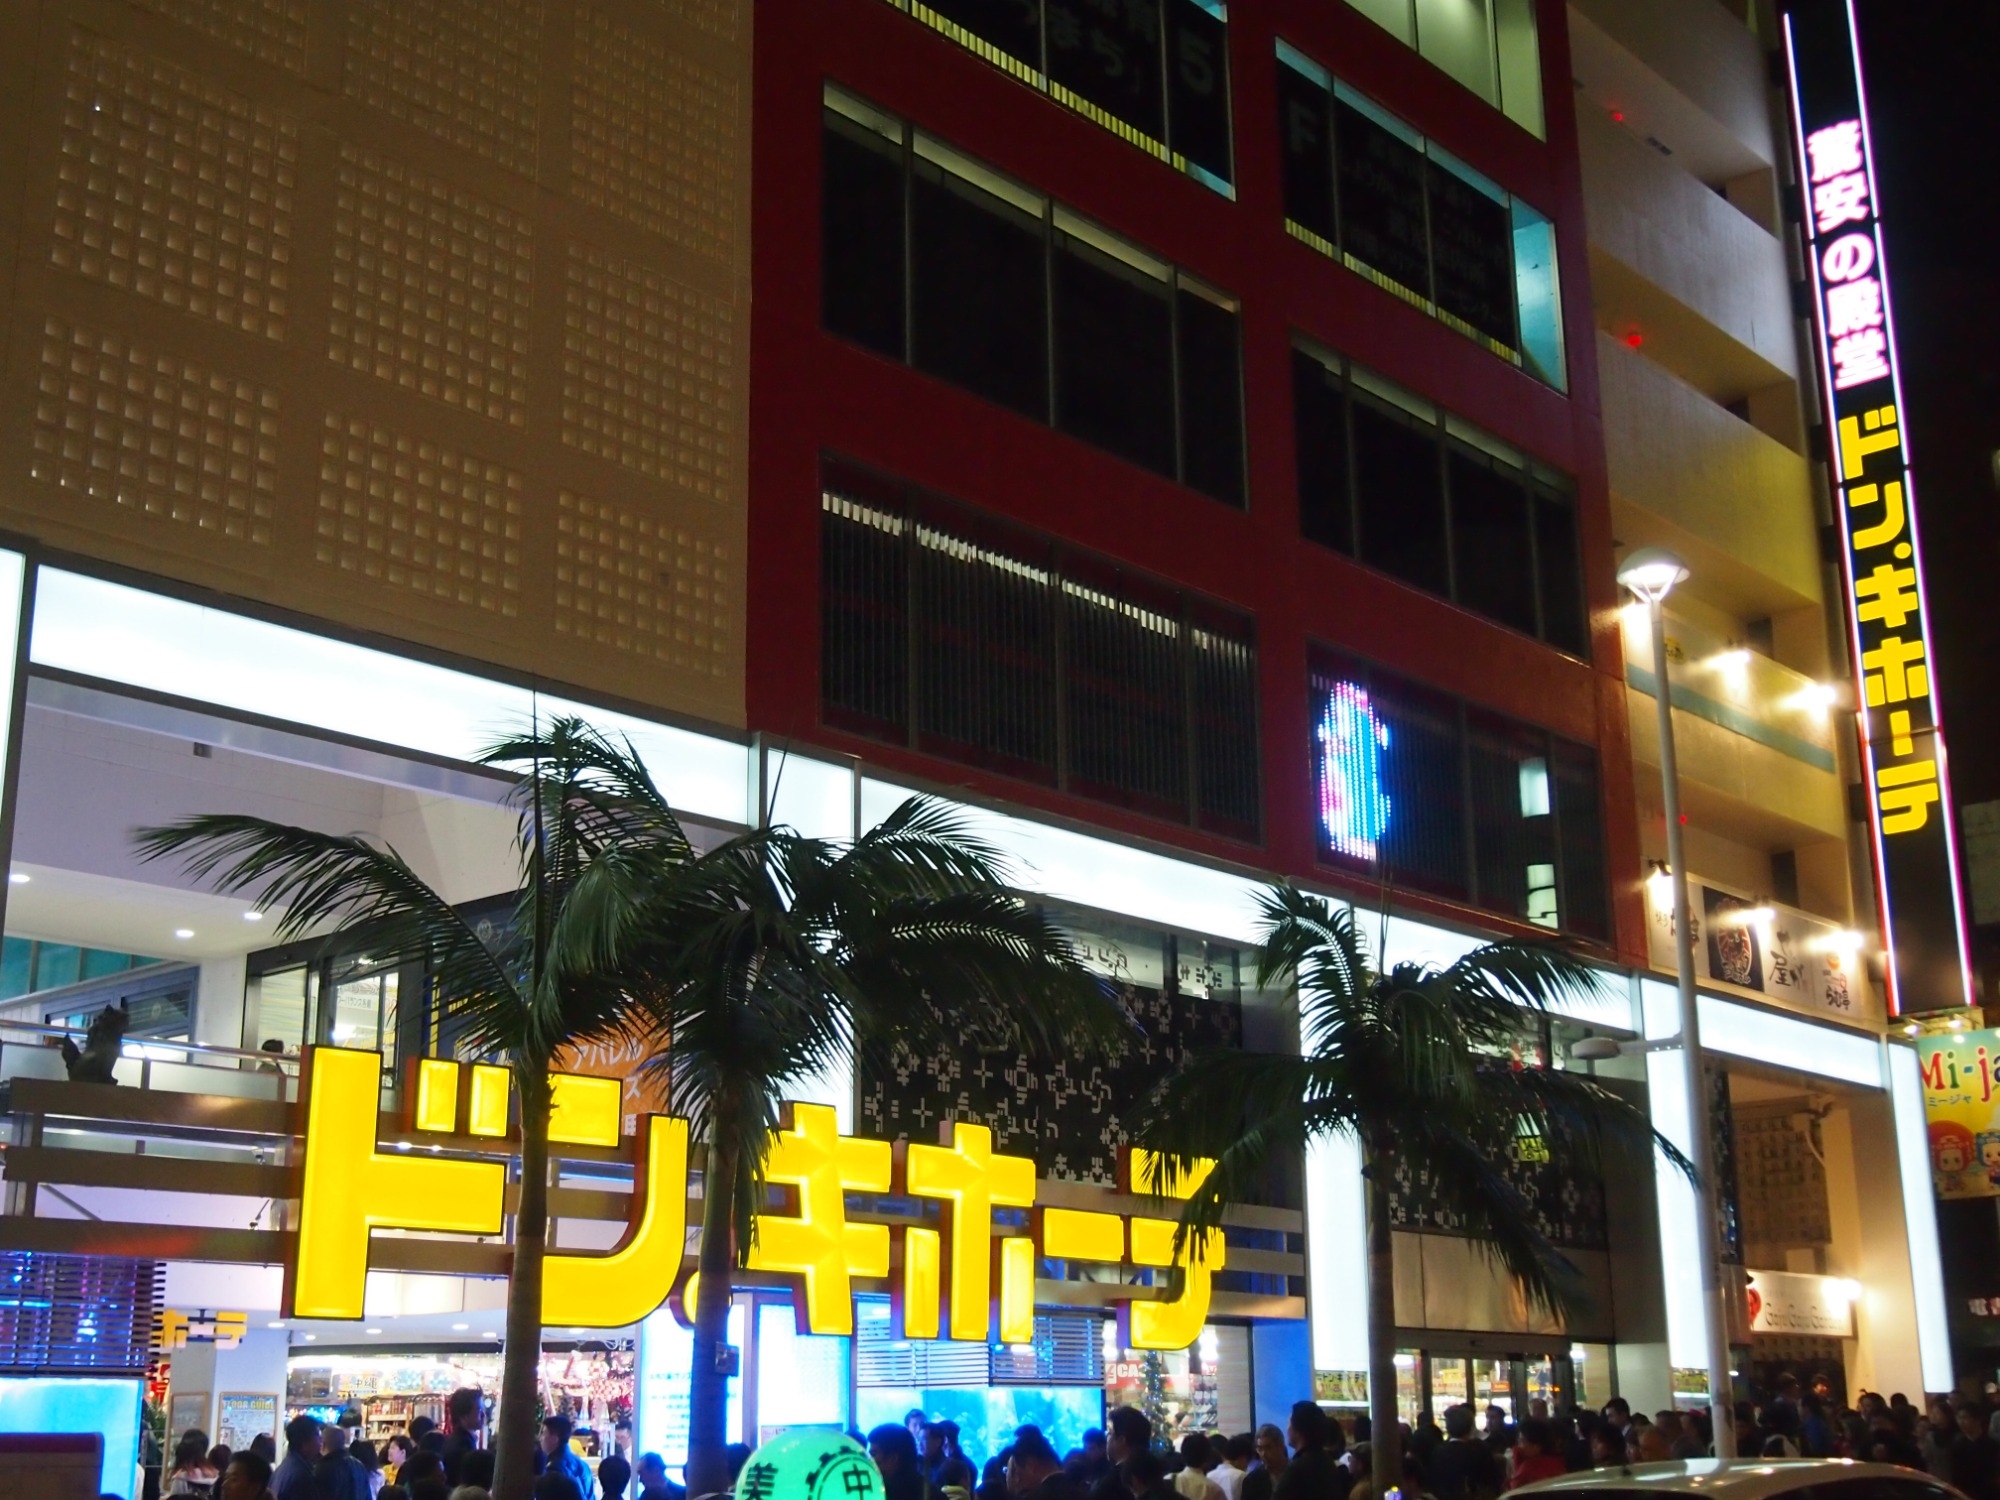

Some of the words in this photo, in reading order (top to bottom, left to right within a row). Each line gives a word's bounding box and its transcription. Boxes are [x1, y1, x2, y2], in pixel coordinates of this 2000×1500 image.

[1807, 118, 1890, 391] 驚安の殿堂
